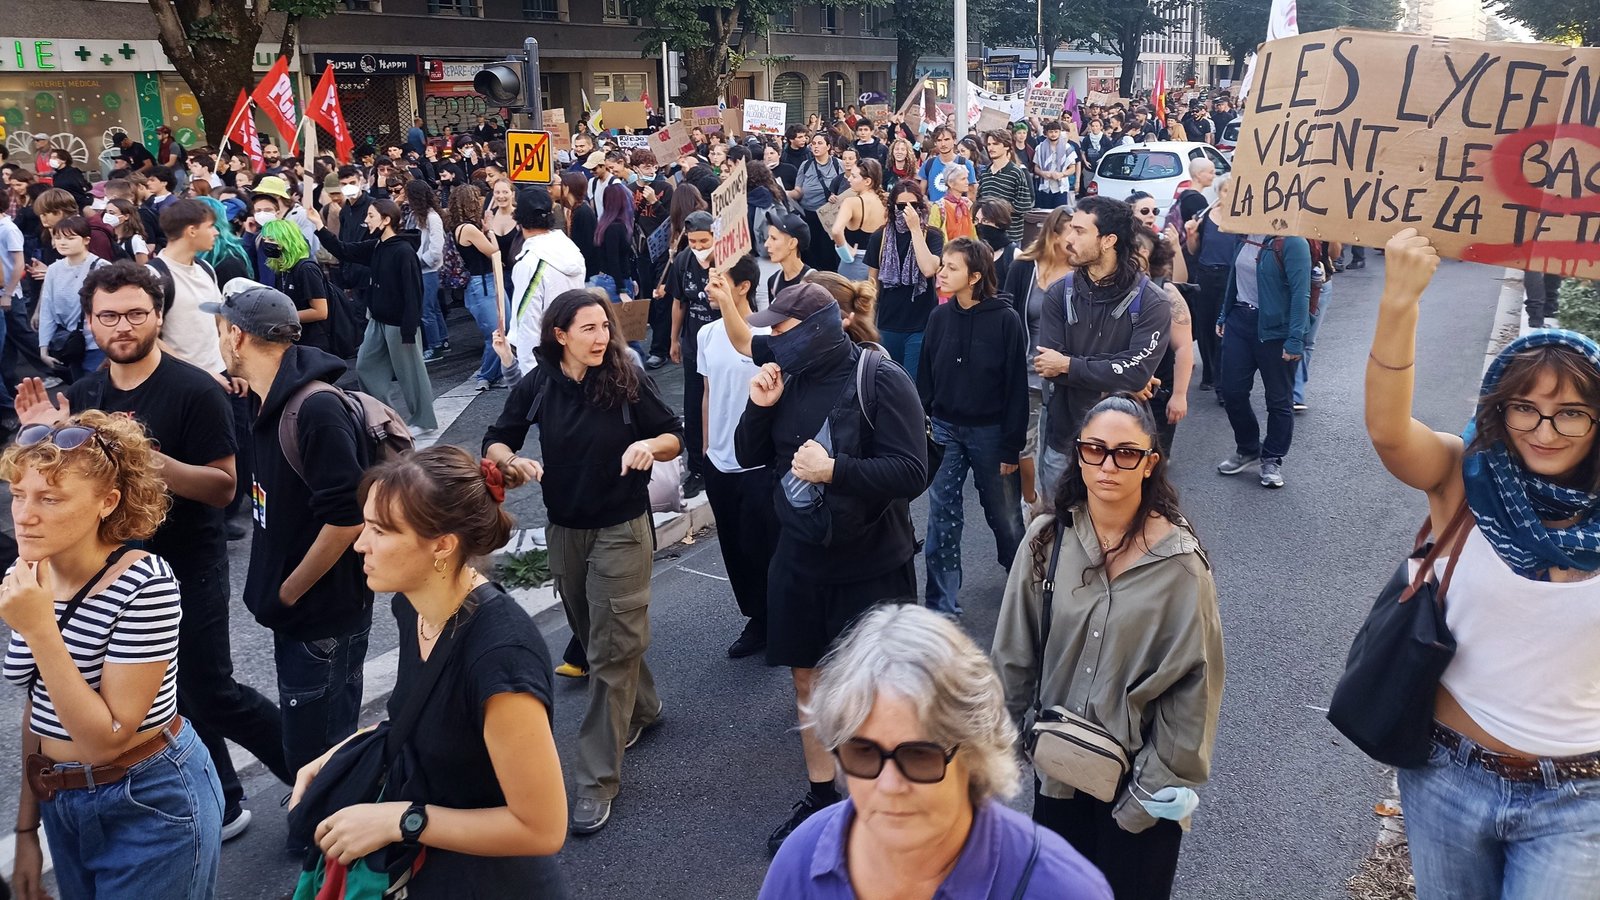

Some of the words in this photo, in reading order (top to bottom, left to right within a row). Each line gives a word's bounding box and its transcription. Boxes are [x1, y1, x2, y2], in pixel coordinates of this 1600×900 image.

[0, 41, 55, 69] IE
[1256, 37, 1360, 117] LES
[513, 143, 545, 171] ADV
[1254, 112, 1399, 173] VISENT
[1435, 136, 1493, 183] LE
[1231, 176, 1254, 217] LA
[1264, 171, 1329, 215] BAC
[1344, 170, 1428, 223] VISE
[1432, 186, 1483, 235] LA
